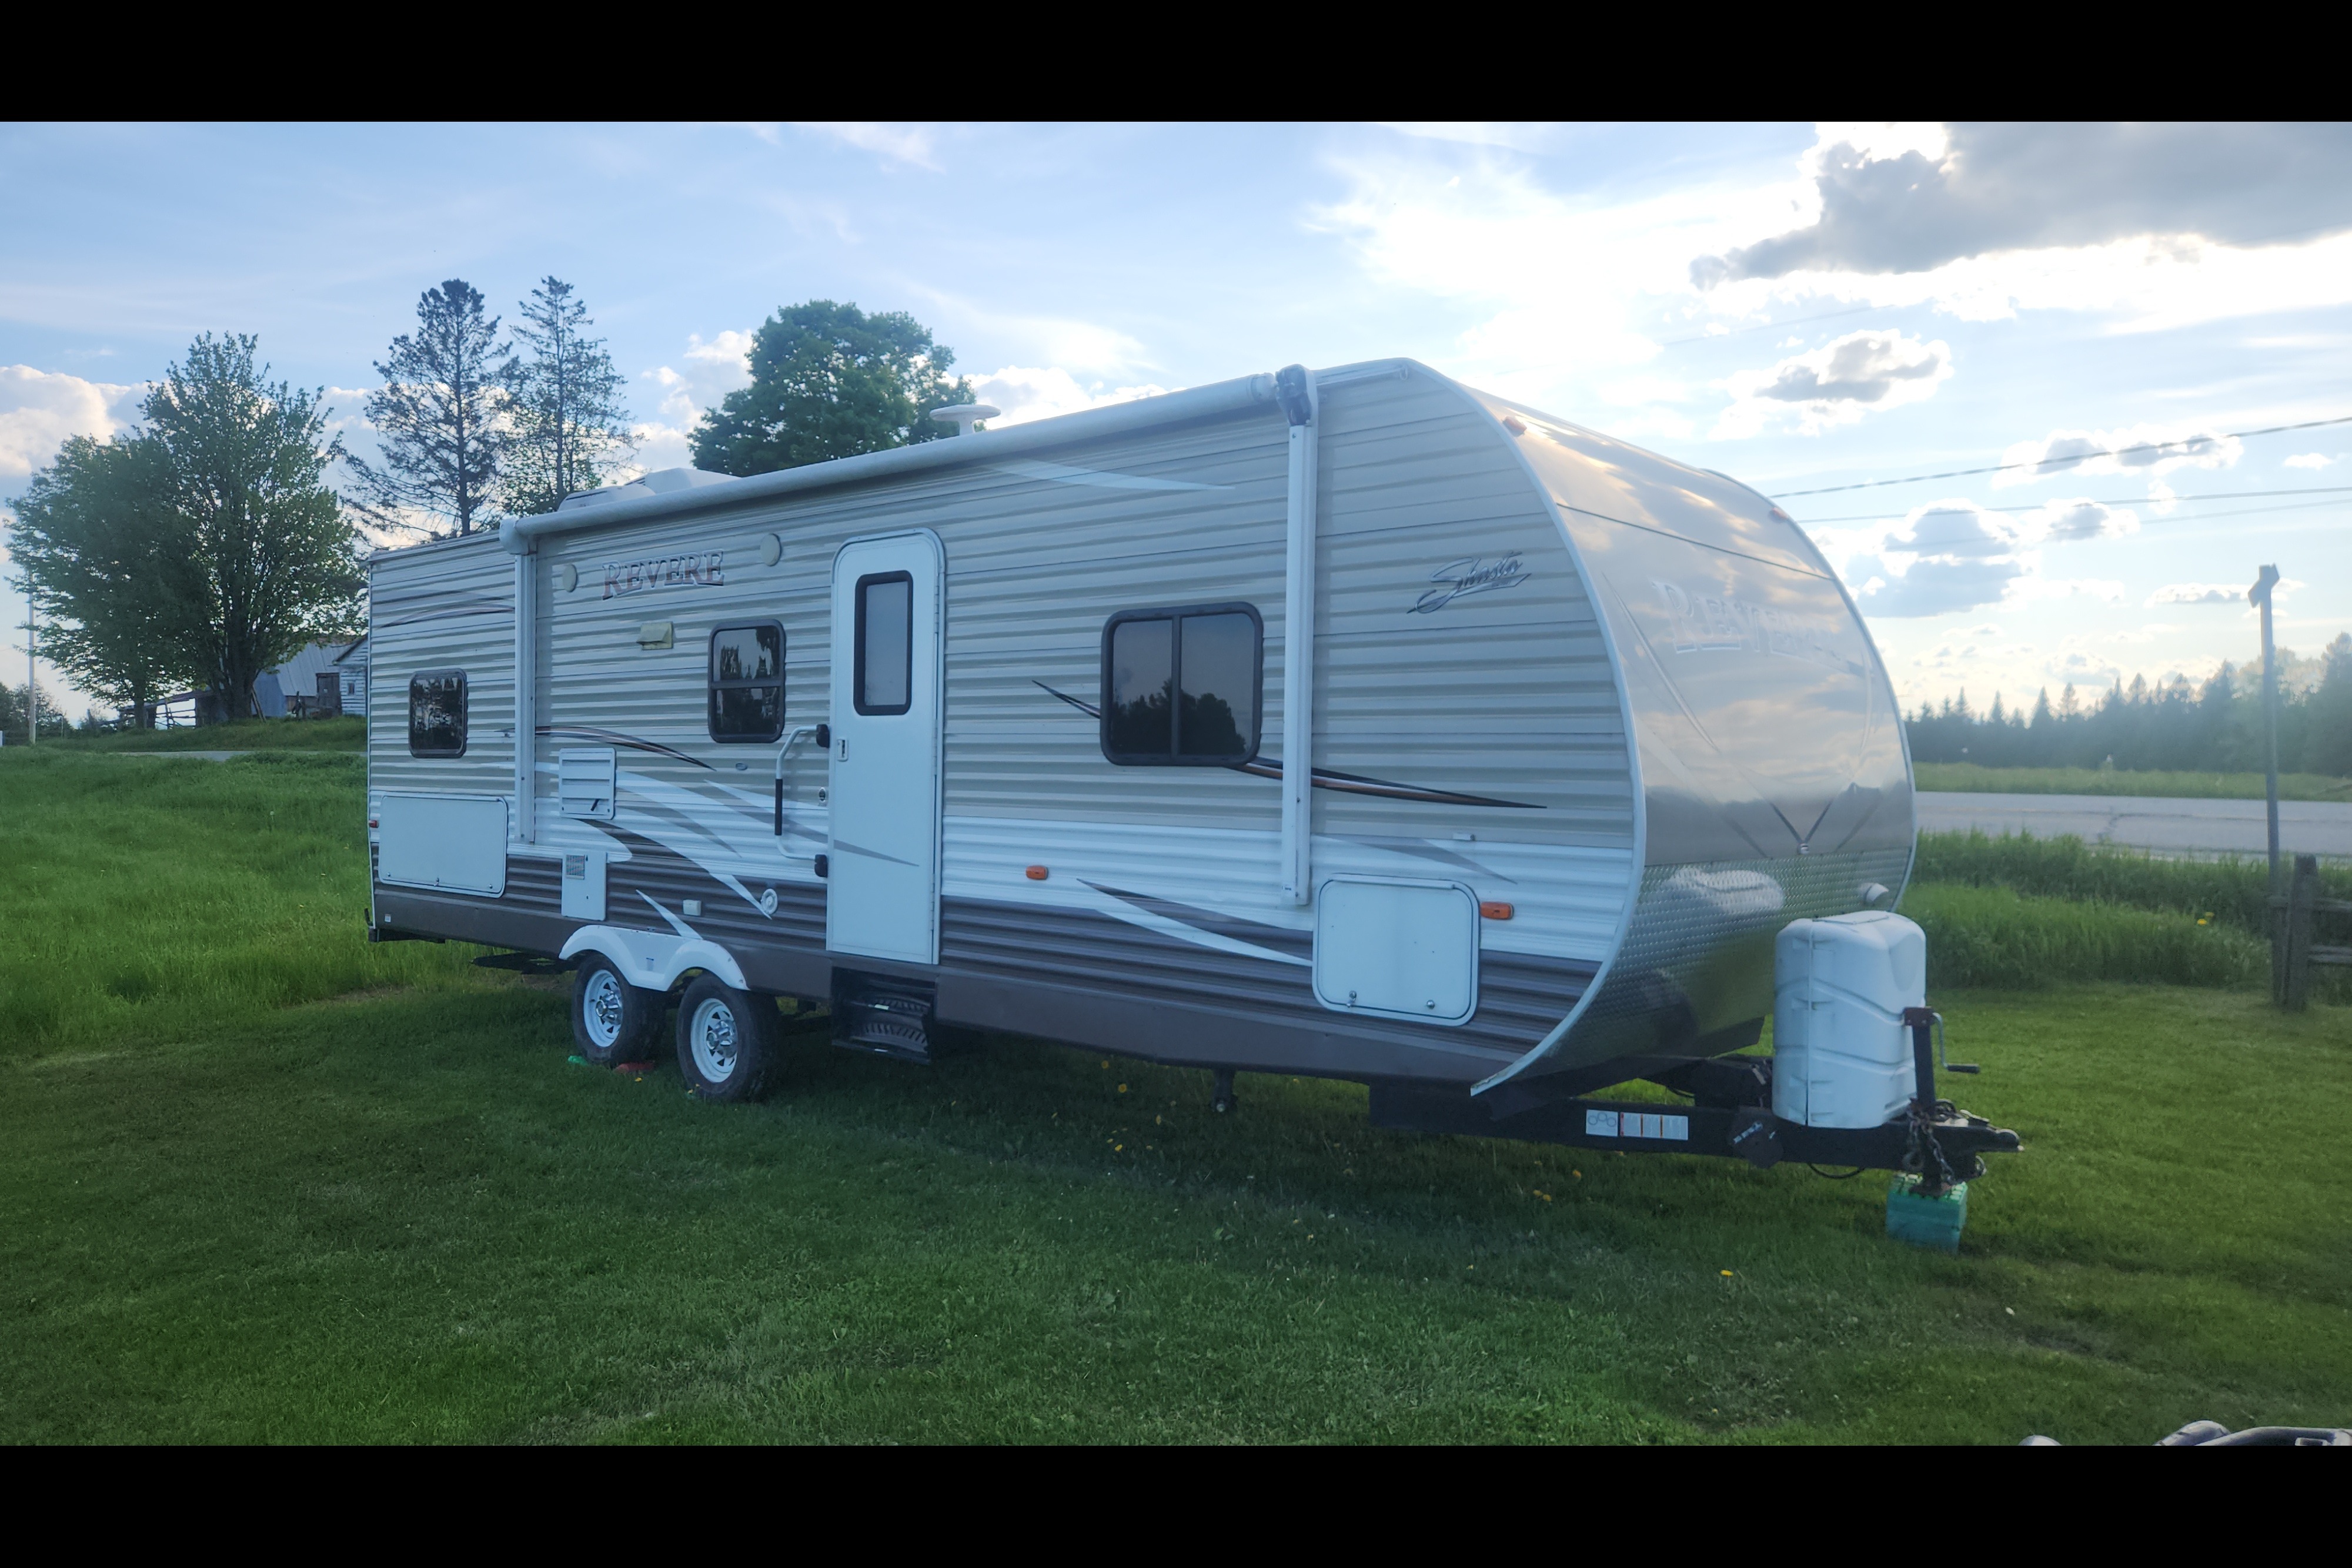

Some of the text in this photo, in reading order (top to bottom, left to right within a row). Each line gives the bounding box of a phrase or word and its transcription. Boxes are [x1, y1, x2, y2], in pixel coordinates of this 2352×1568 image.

[602, 550, 724, 600] REVERE
[1406, 549, 1523, 614] Shasta
[1649, 577, 1851, 671] REVE
